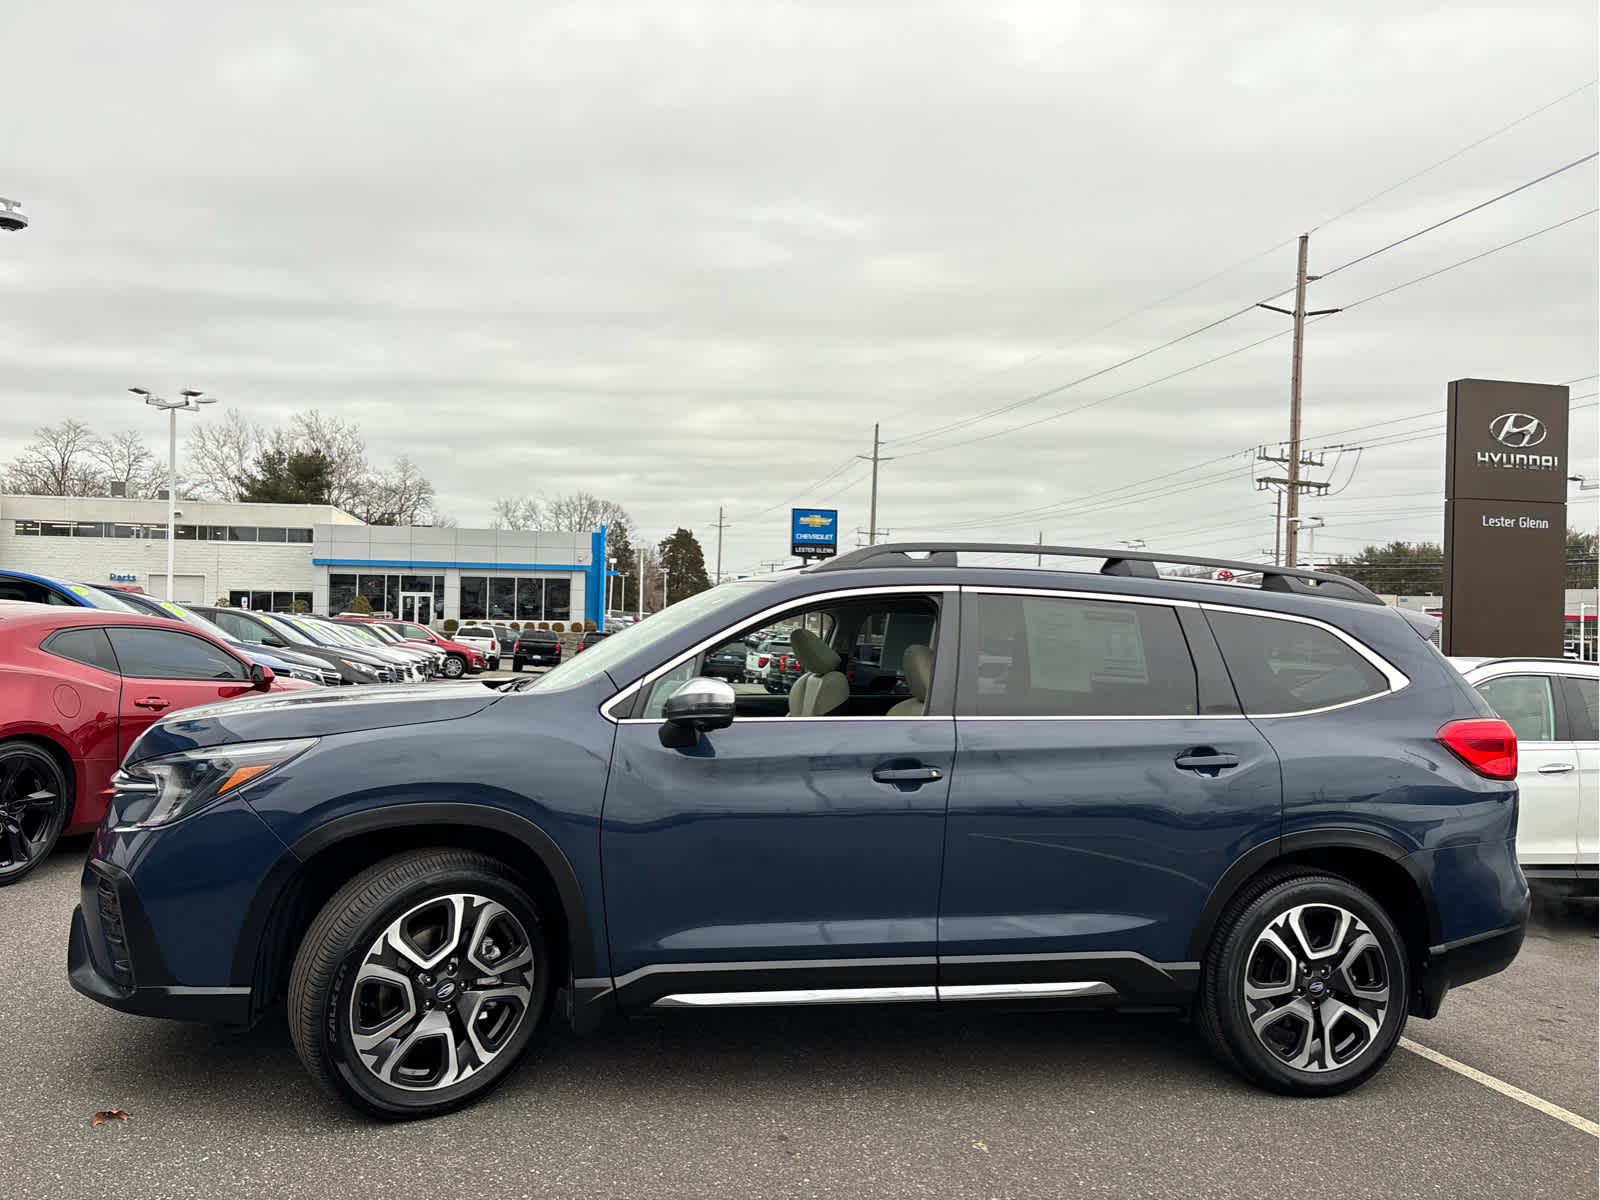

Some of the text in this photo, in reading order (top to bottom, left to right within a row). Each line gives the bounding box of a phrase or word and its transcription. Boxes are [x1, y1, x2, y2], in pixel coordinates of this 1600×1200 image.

[1476, 451, 1559, 470] HYUNDAI
[1482, 515, 1549, 529] Lester Glenn
[109, 573, 137, 582] Parts
